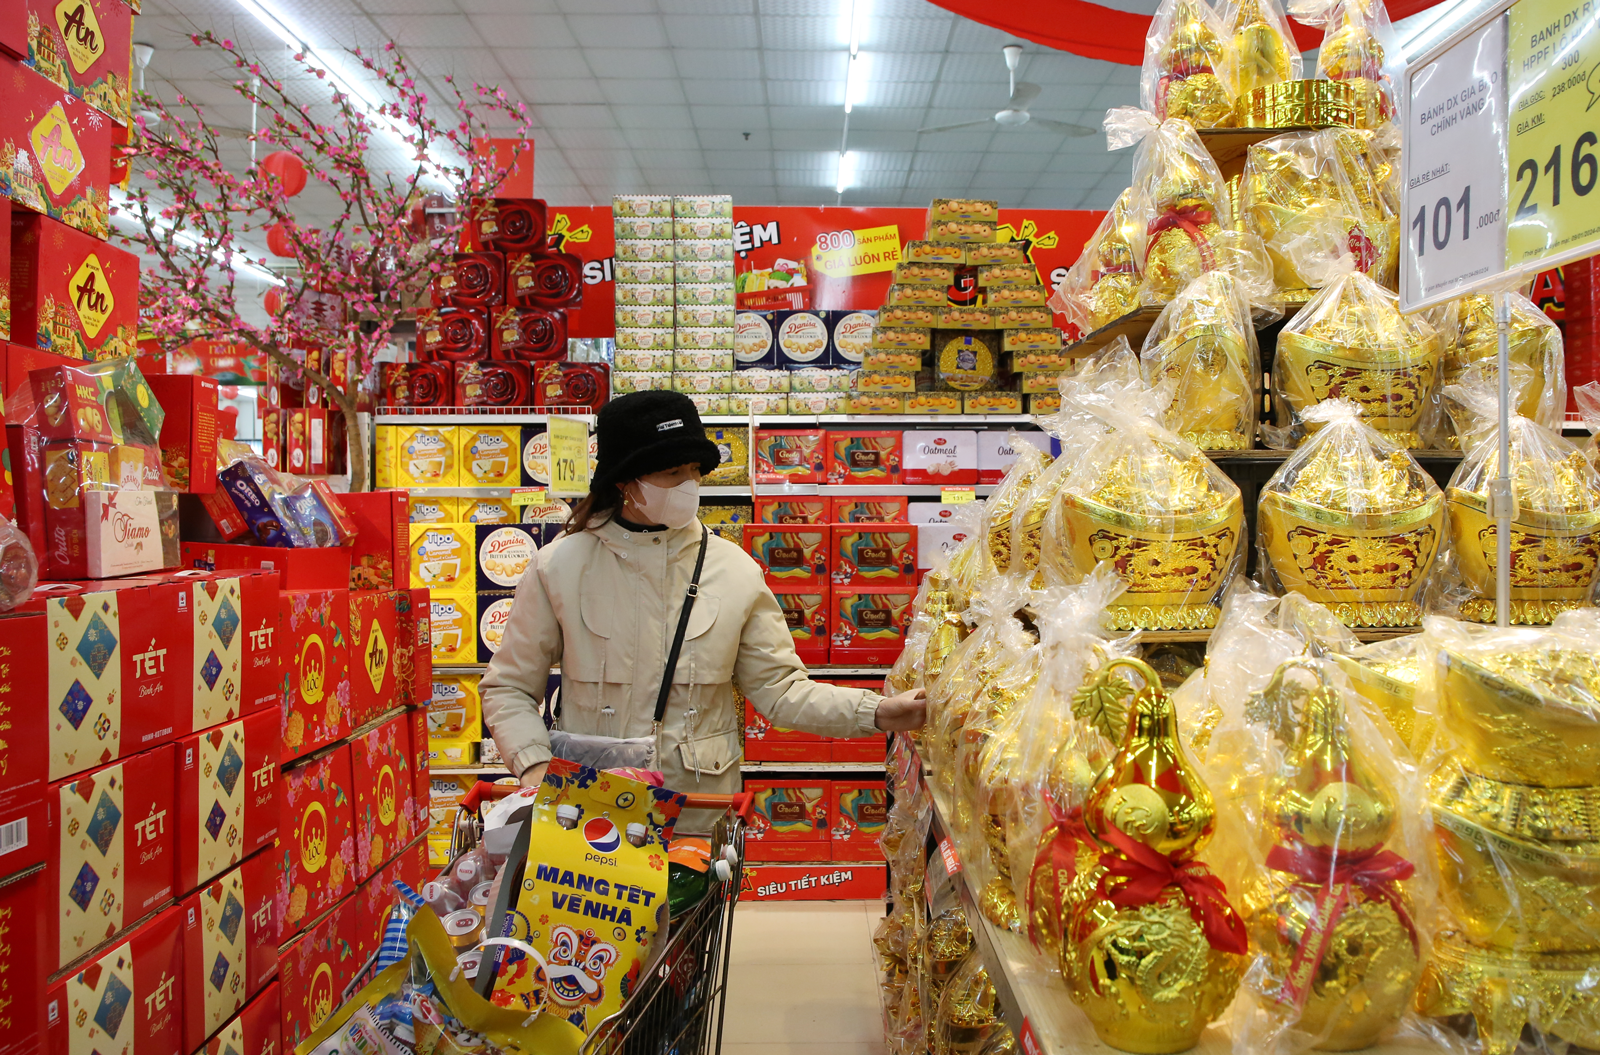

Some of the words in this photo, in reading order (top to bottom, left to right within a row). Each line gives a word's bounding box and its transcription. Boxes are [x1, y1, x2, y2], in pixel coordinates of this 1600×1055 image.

[64, 4, 98, 52] An
[1561, 49, 1580, 71] 300
[1447, 94, 1459, 111] DX
[1460, 85, 1476, 103] GIA
[40, 124, 77, 170] An
[1514, 131, 1599, 222] 216
[1412, 185, 1471, 257] 101
[817, 229, 855, 251] 800
[848, 250, 881, 268] LUÔN
[76, 271, 108, 315] An
[415, 433, 439, 447] Tipo
[477, 433, 502, 447] Tipo
[923, 445, 957, 455] Oatmeal
[556, 457, 575, 481] 179
[236, 480, 260, 506] OREO
[414, 503, 438, 516] Tipo
[477, 502, 501, 516] Tipo
[530, 503, 564, 519] Danisa
[426, 532, 453, 547] Tipo
[488, 535, 526, 554] Danisa
[249, 617, 274, 651] TẾT
[132, 637, 167, 679] TẾT
[369, 635, 385, 676] An
[432, 682, 458, 695] Tipo
[252, 754, 276, 792] TẾT
[431, 779, 458, 792] Tipo
[134, 802, 167, 847] TẾT
[584, 852, 618, 867] pepsi
[536, 863, 611, 896] MANG
[613, 882, 656, 908] TẾT
[757, 880, 786, 897] SIÊU
[788, 873, 818, 891] TIẾT
[820, 870, 853, 886] KIỆM
[252, 894, 273, 934] TẾT
[583, 899, 633, 927] NHÀ
[144, 971, 175, 1020] TẾT
